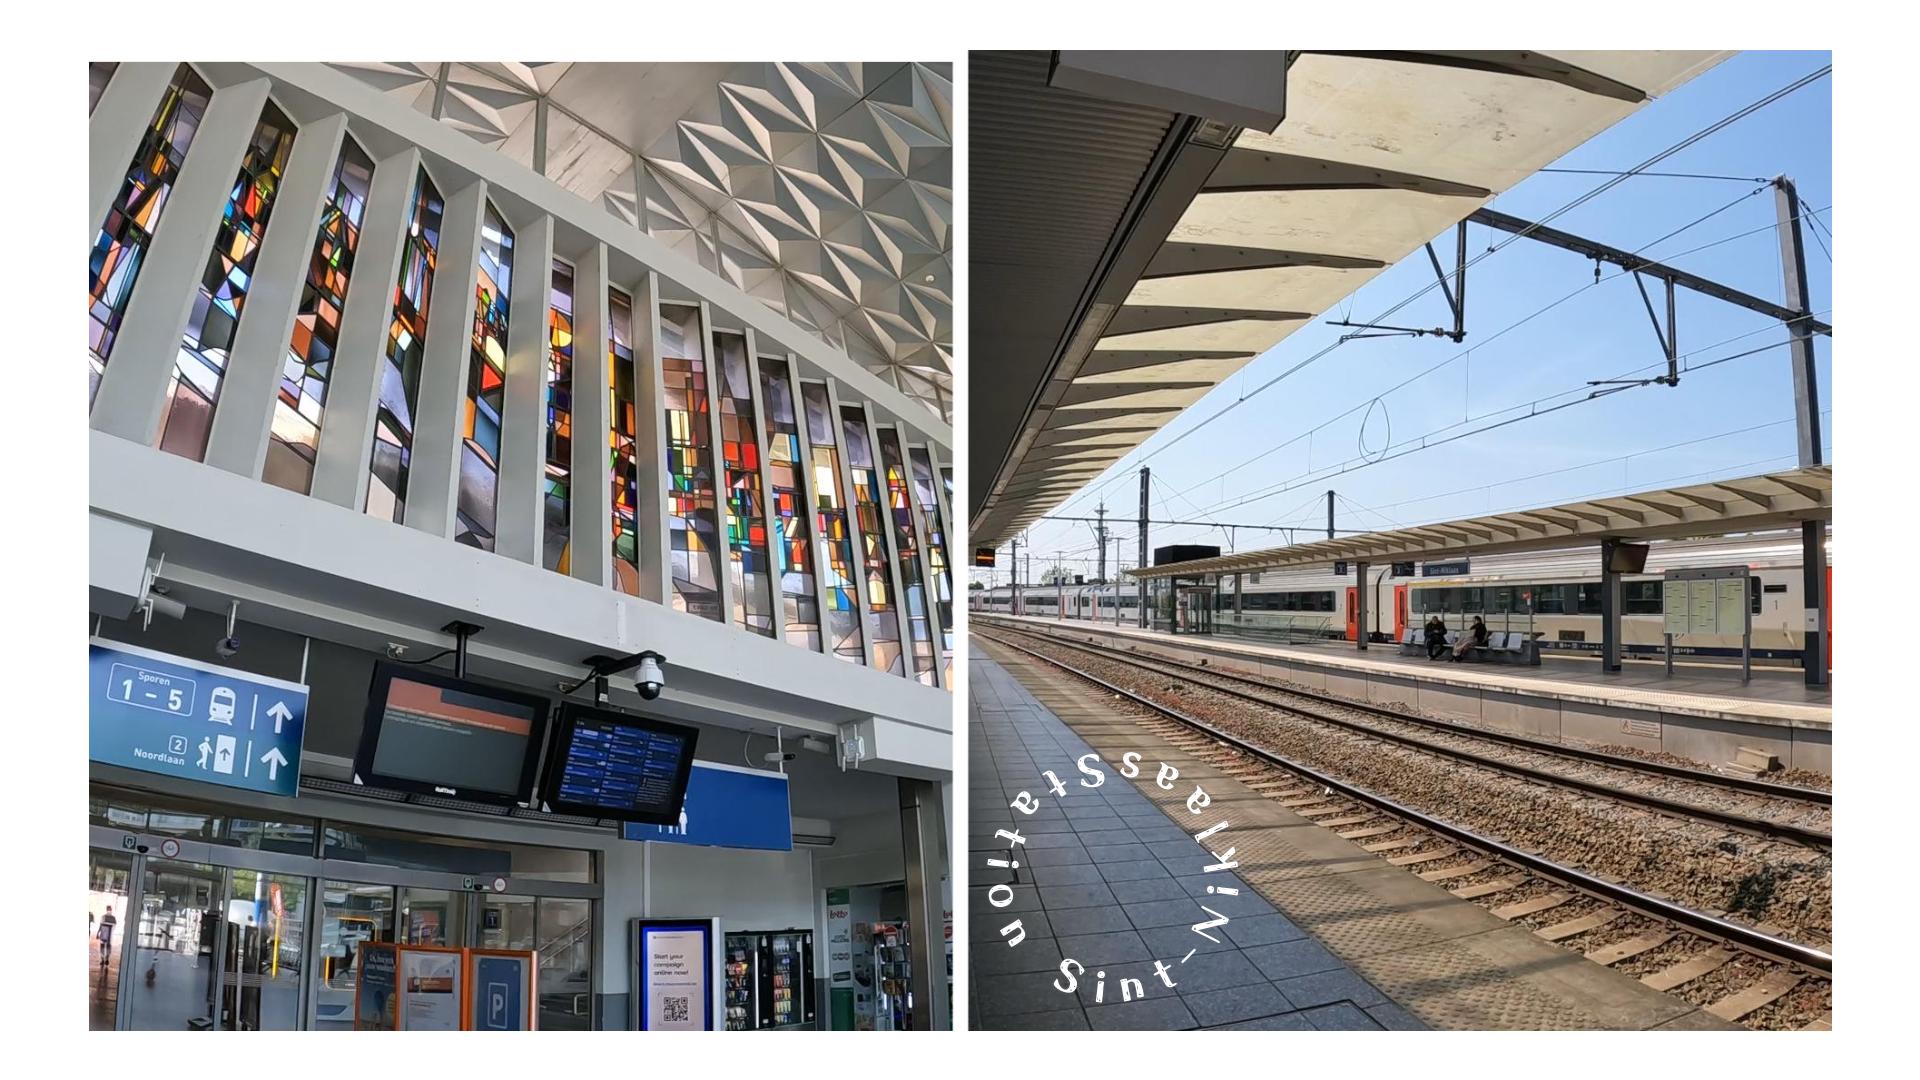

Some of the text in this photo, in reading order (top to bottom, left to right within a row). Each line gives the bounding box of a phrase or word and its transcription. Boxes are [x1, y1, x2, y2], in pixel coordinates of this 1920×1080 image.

[138, 671, 170, 686] Sporen
[122, 679, 133, 700] 1
[168, 688, 183, 710] 5
[174, 739, 182, 750] 2
[134, 748, 184, 766] Noordlaan
[653, 961, 685, 969] campaign
[492, 993, 504, 1020] P
